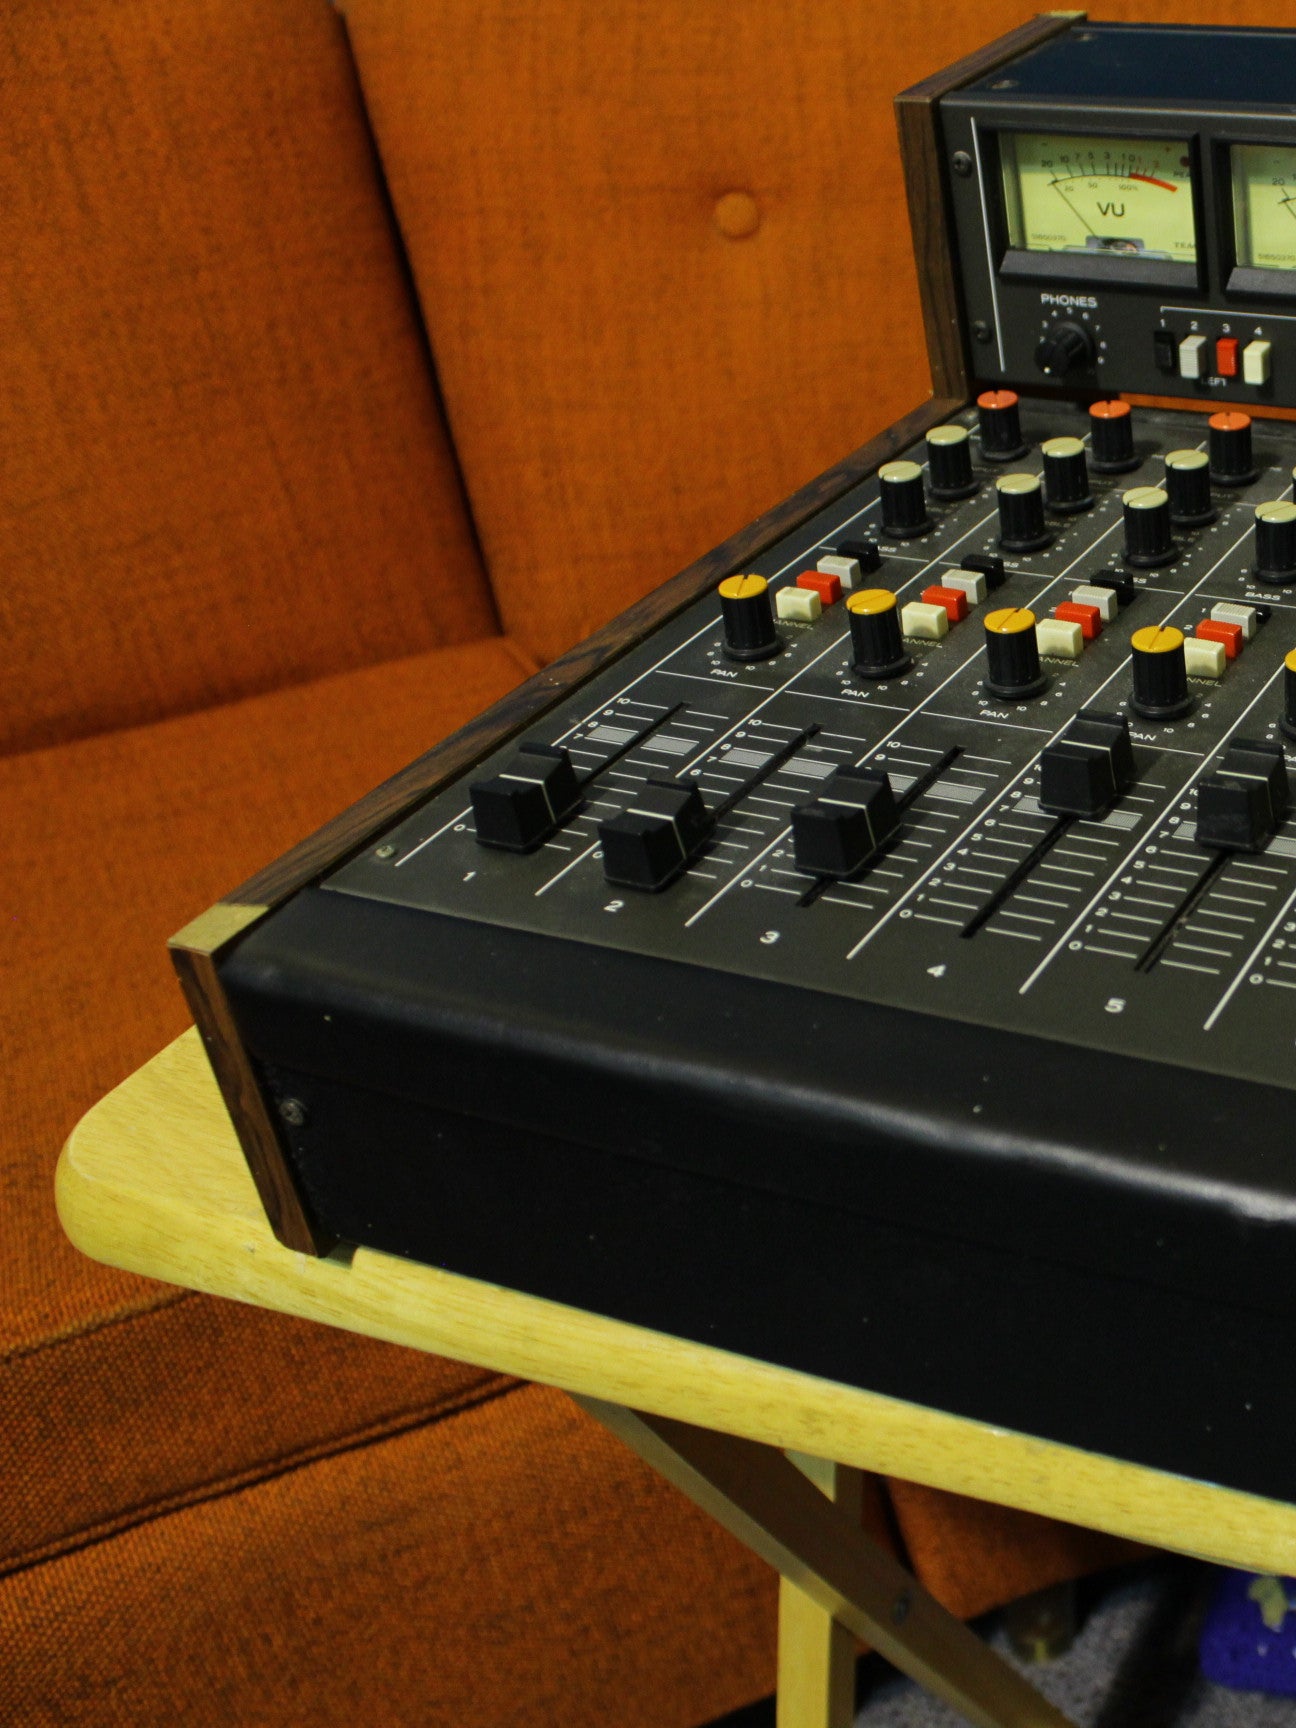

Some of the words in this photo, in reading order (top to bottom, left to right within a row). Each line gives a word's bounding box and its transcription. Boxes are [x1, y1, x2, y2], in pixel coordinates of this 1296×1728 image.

[1272, 178, 1284, 186] 20
[1097, 202, 1125, 217] VU
[1041, 294, 1098, 308] PHONES
[1190, 321, 1199, 330] 2
[1222, 324, 1231, 333] 3
[1254, 326, 1263, 335] 4
[1245, 592, 1281, 600] BASS
[710, 669, 738, 678] PAN
[841, 688, 870, 698] PAN
[980, 709, 1009, 720] PAN
[1130, 732, 1156, 741] PAN
[451, 822, 465, 831] 0
[971, 833, 982, 841] 5
[1133, 861, 1145, 869] 5
[463, 872, 475, 881] 1
[741, 879, 753, 887] 0
[928, 878, 941, 886] 2
[1108, 892, 1121, 900] 3
[604, 900, 623, 912] 2
[899, 909, 912, 918] 0
[1095, 908, 1108, 917] 2
[760, 931, 779, 943] 3
[1069, 941, 1082, 950] 0
[1265, 957, 1271, 965] 1
[927, 965, 945, 977] 4
[1249, 974, 1263, 984] 0
[1104, 997, 1126, 1013] 5
